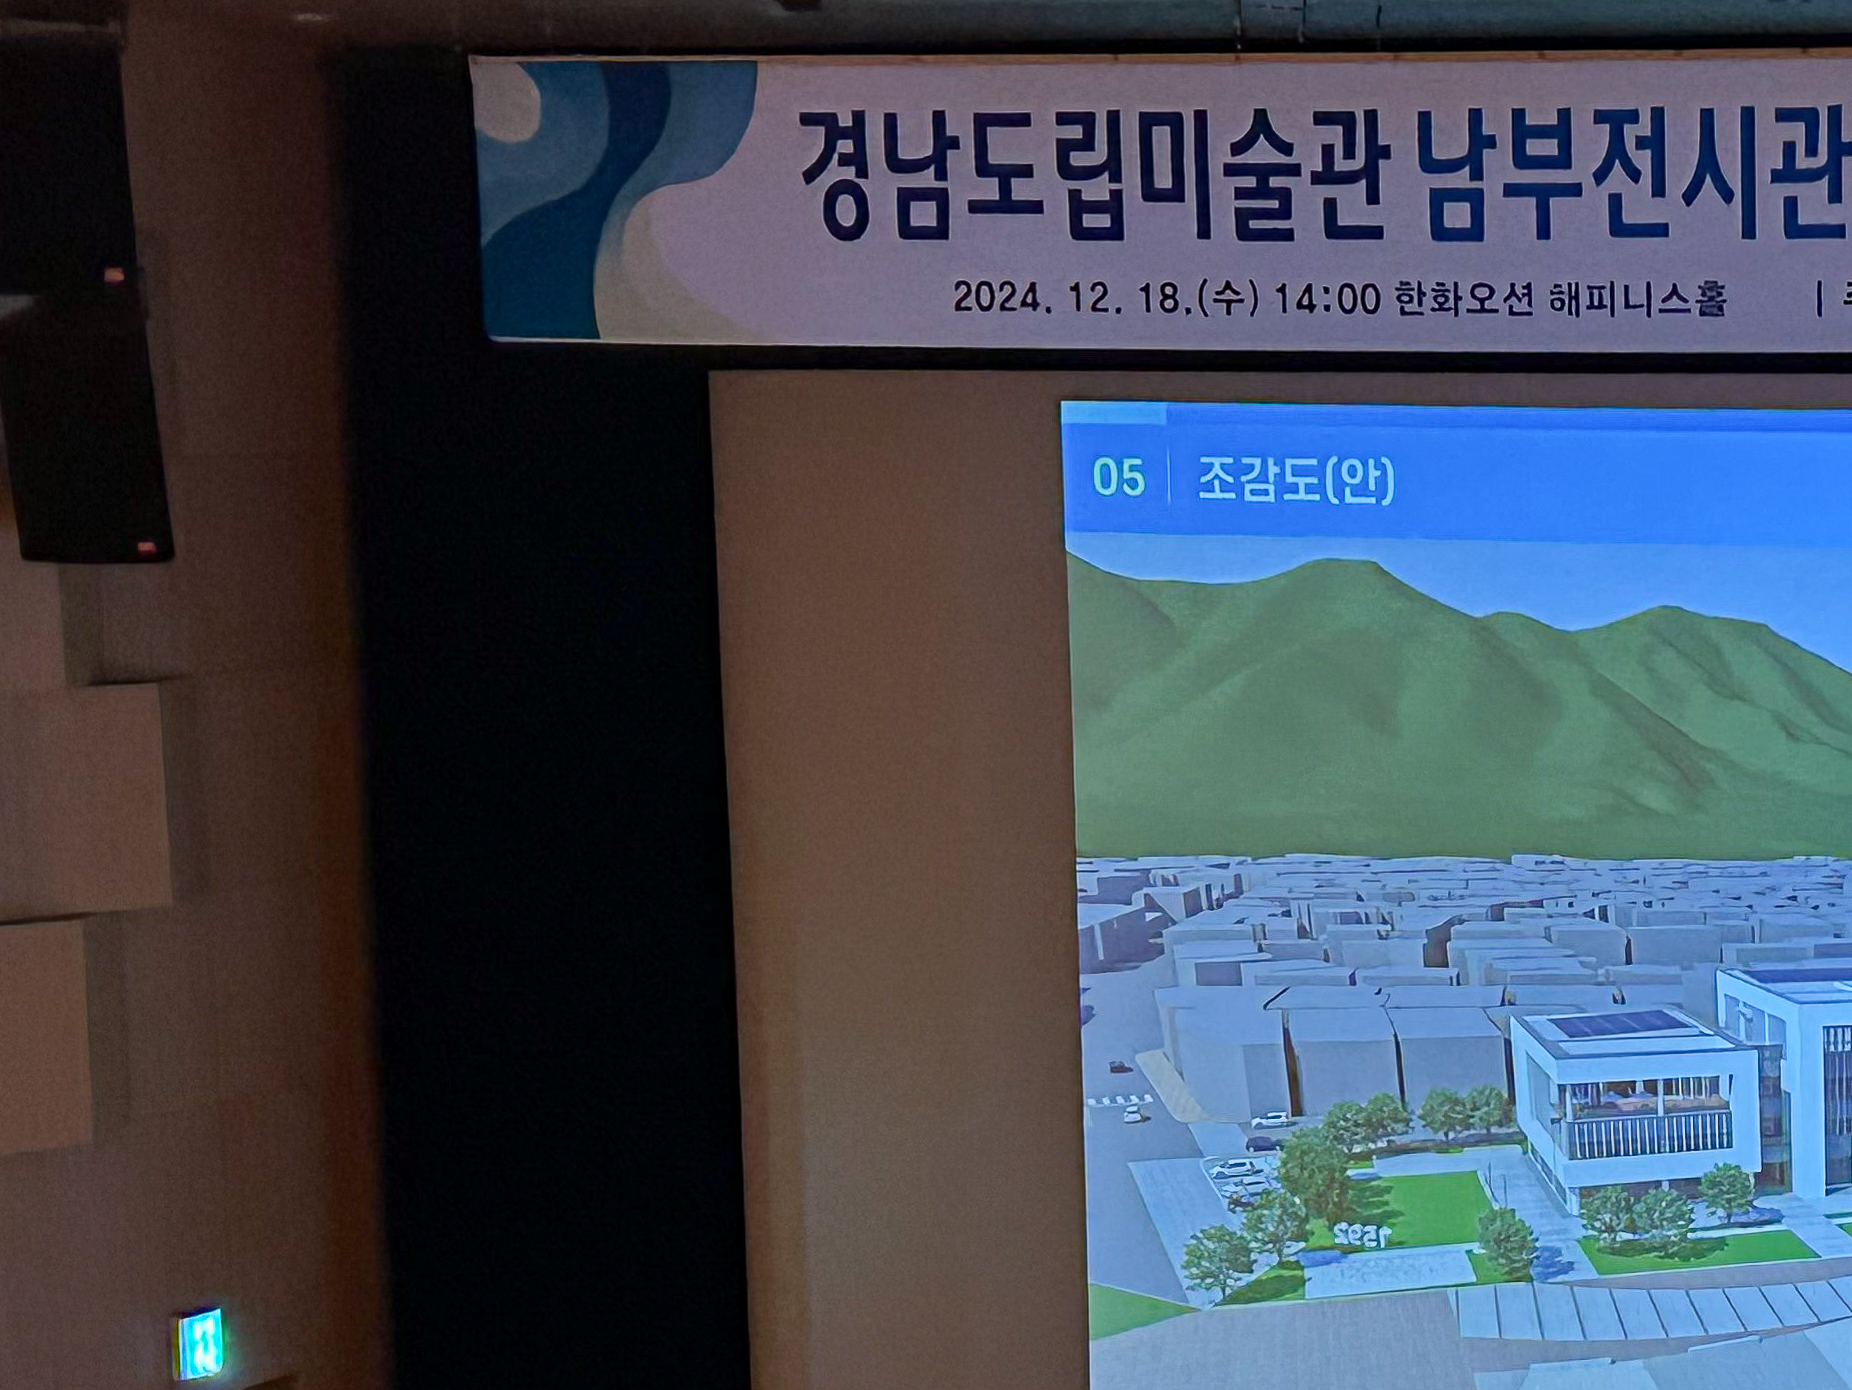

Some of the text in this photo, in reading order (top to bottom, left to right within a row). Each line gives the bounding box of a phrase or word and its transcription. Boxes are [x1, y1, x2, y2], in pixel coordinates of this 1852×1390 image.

[799, 108, 1391, 242] 경남도립미술관
[955, 281, 1052, 314] 2024.
[1069, 282, 1122, 314] 12.
[1276, 283, 1381, 314] 14:00
[1394, 281, 1533, 317] 한화오션
[1550, 281, 1728, 318] 해피니스홀
[1094, 457, 1144, 495] 05
[1200, 456, 1394, 506] 조감도(안)
